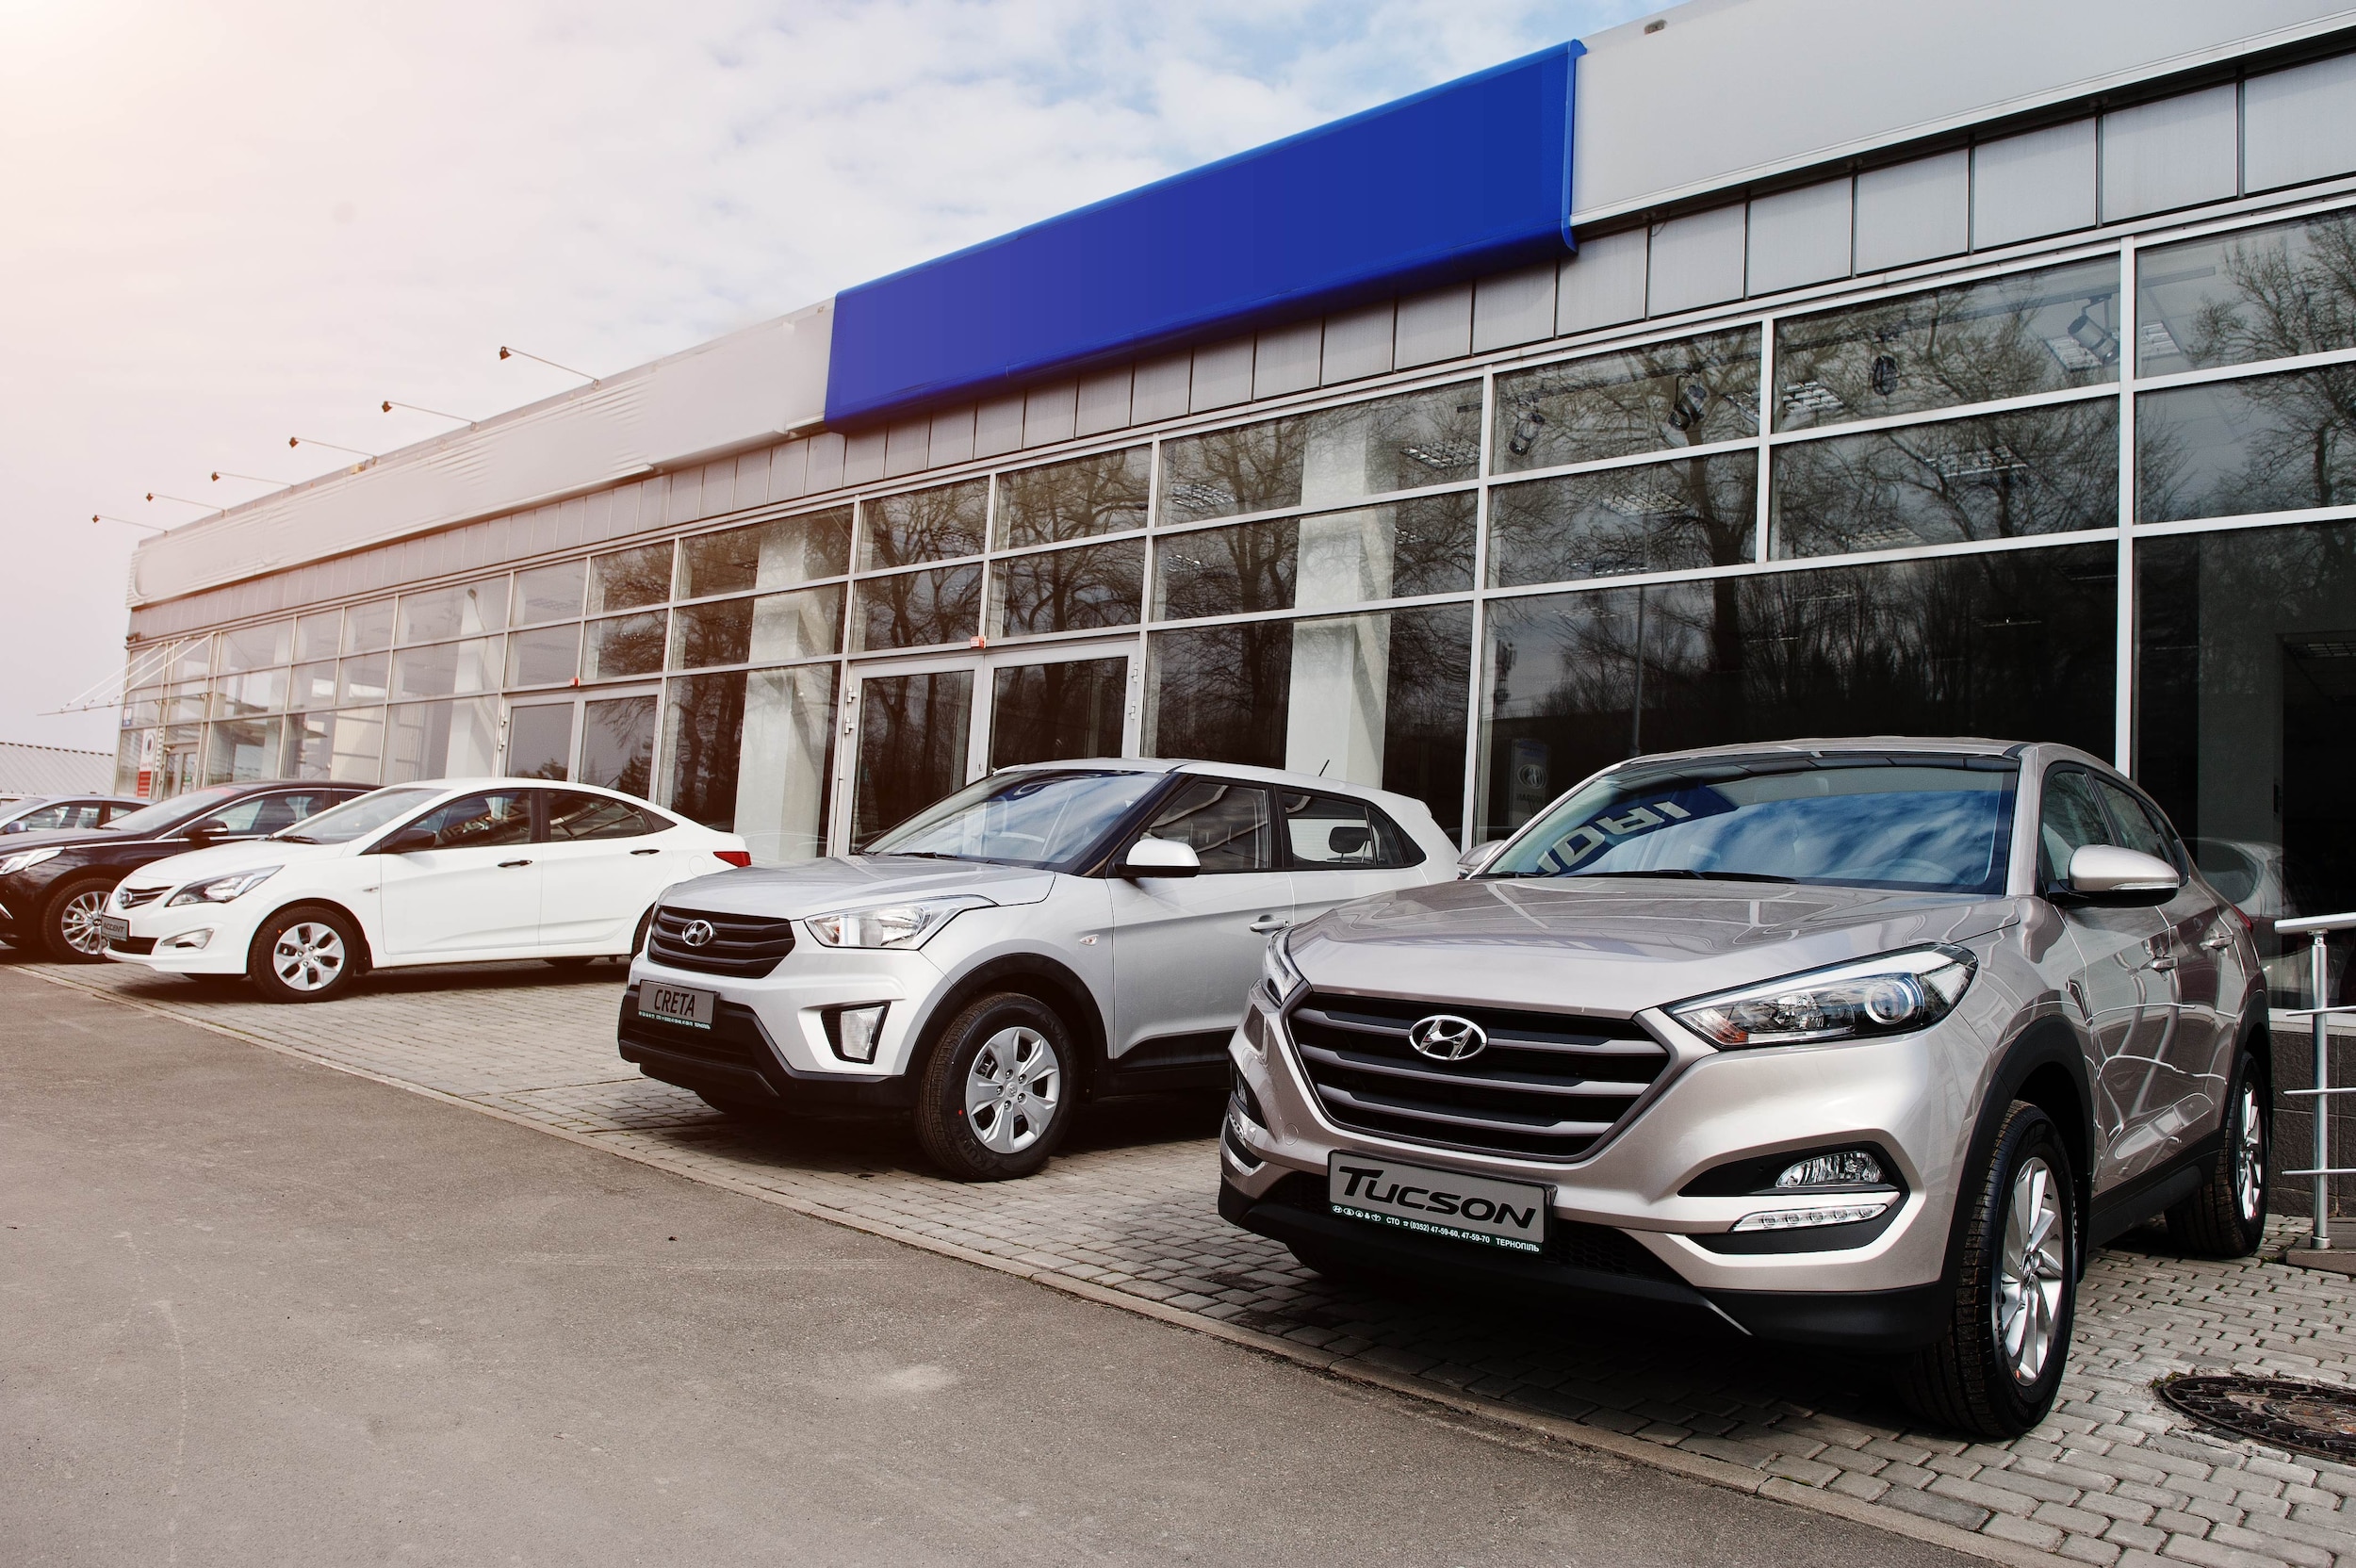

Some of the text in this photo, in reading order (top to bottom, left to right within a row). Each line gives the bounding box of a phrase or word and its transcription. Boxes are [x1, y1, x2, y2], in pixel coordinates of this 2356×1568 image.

[103, 922, 124, 933] ACCENT
[654, 988, 695, 1017] CRETA
[1338, 1166, 1536, 1229] TUCSON
[1385, 1217, 1400, 1226] СТО
[1410, 1221, 1430, 1233] (0352)
[1461, 1232, 1490, 1244] 47-59-70
[1496, 1237, 1540, 1252] ТЕРНОПІЛЬ
